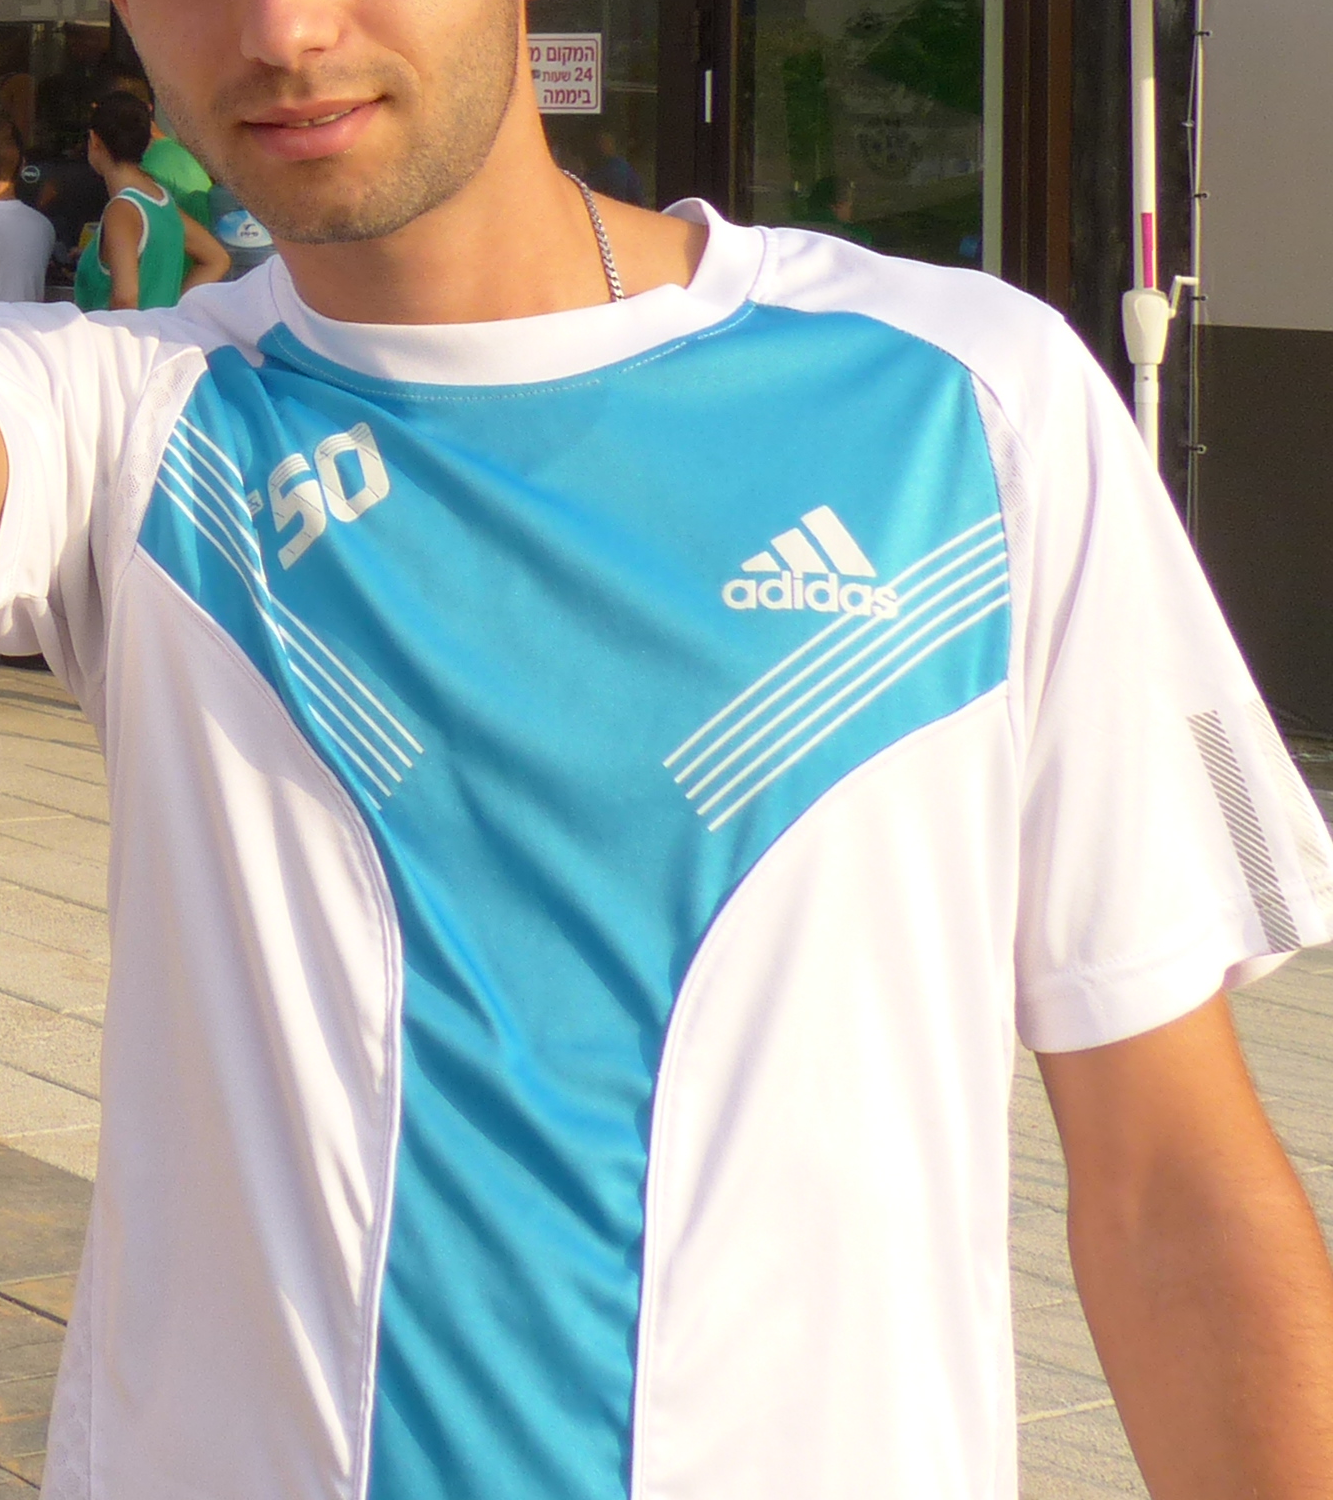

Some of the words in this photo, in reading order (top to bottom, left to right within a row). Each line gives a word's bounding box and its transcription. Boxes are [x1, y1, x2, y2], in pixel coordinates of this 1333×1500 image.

[546, 46, 595, 66] המקום
[542, 70, 572, 82] שעות
[574, 67, 593, 82] 24
[543, 89, 591, 105] ביממה
[246, 421, 391, 571] 50
[721, 569, 899, 620] adidas
